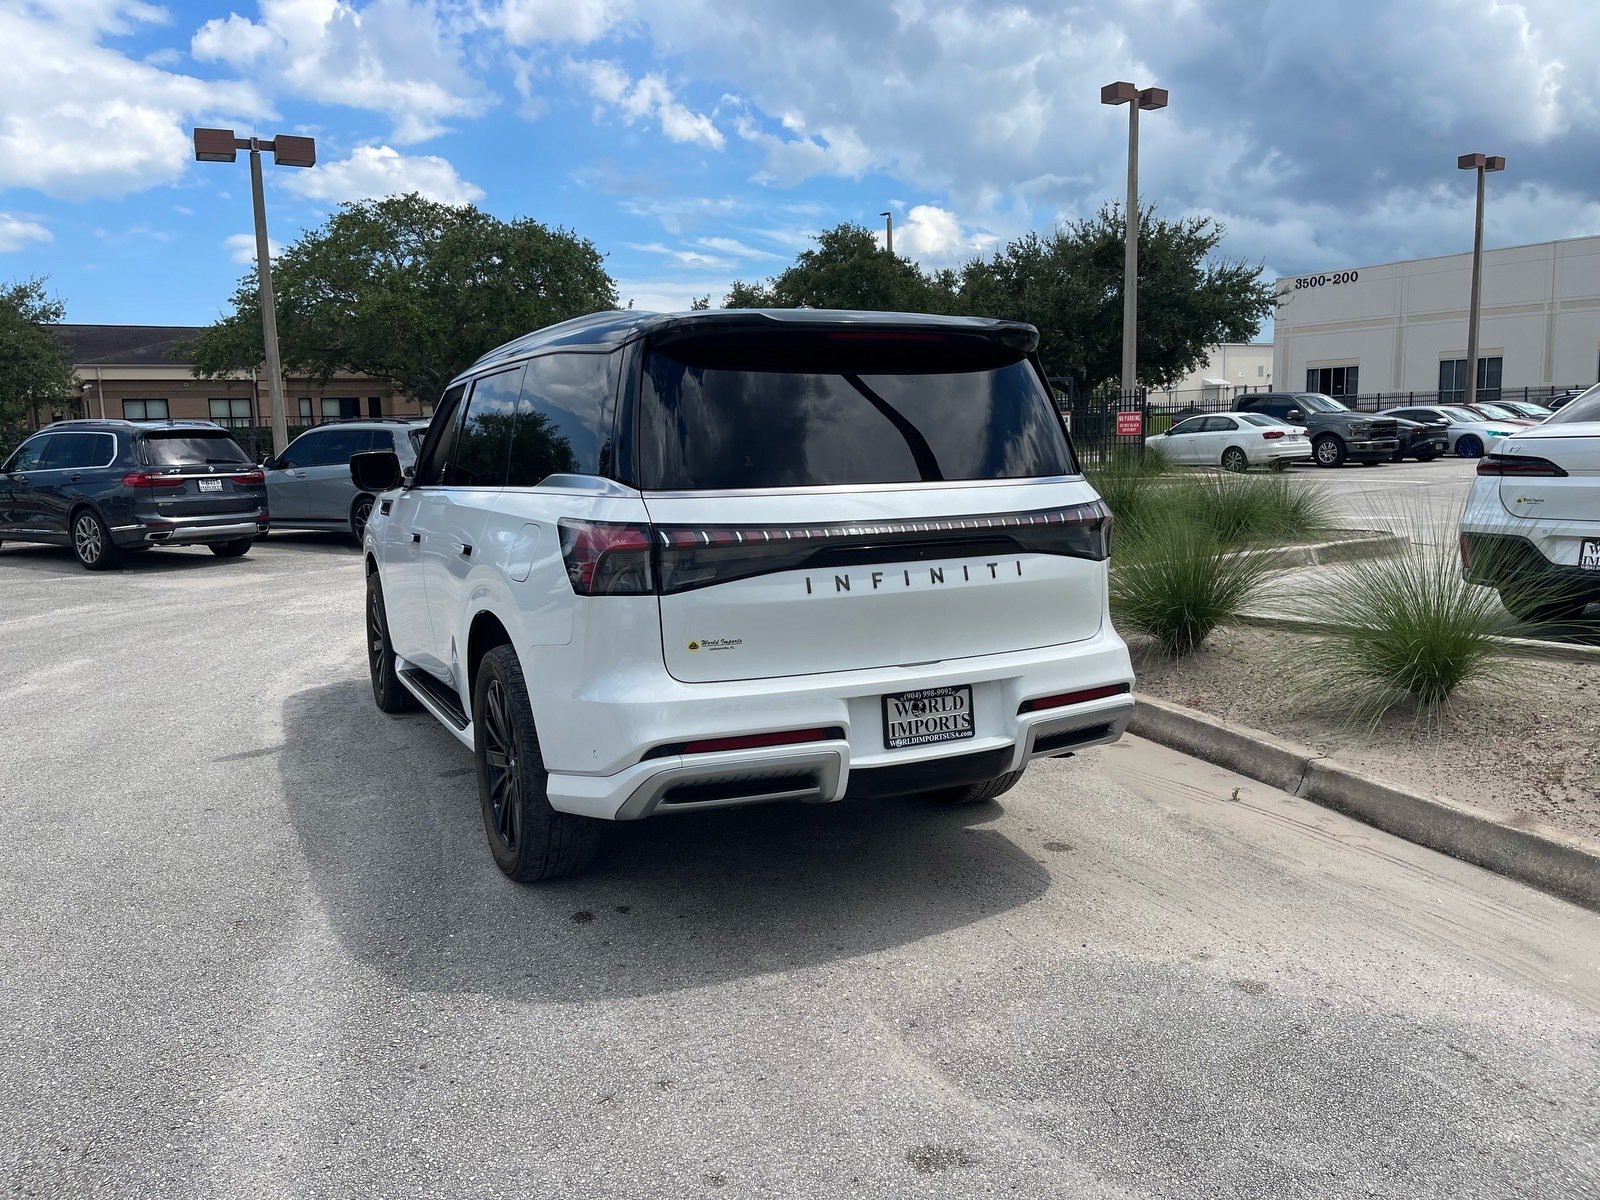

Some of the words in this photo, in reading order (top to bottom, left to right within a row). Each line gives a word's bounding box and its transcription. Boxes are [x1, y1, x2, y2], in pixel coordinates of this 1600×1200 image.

[1295, 271, 1359, 290] 3500-200
[805, 560, 1023, 594] INFINITI
[903, 691, 922, 701] (904)
[922, 688, 952, 698] 998-9992
[894, 695, 965, 718] WORLD
[890, 712, 971, 738] IMPORTS
